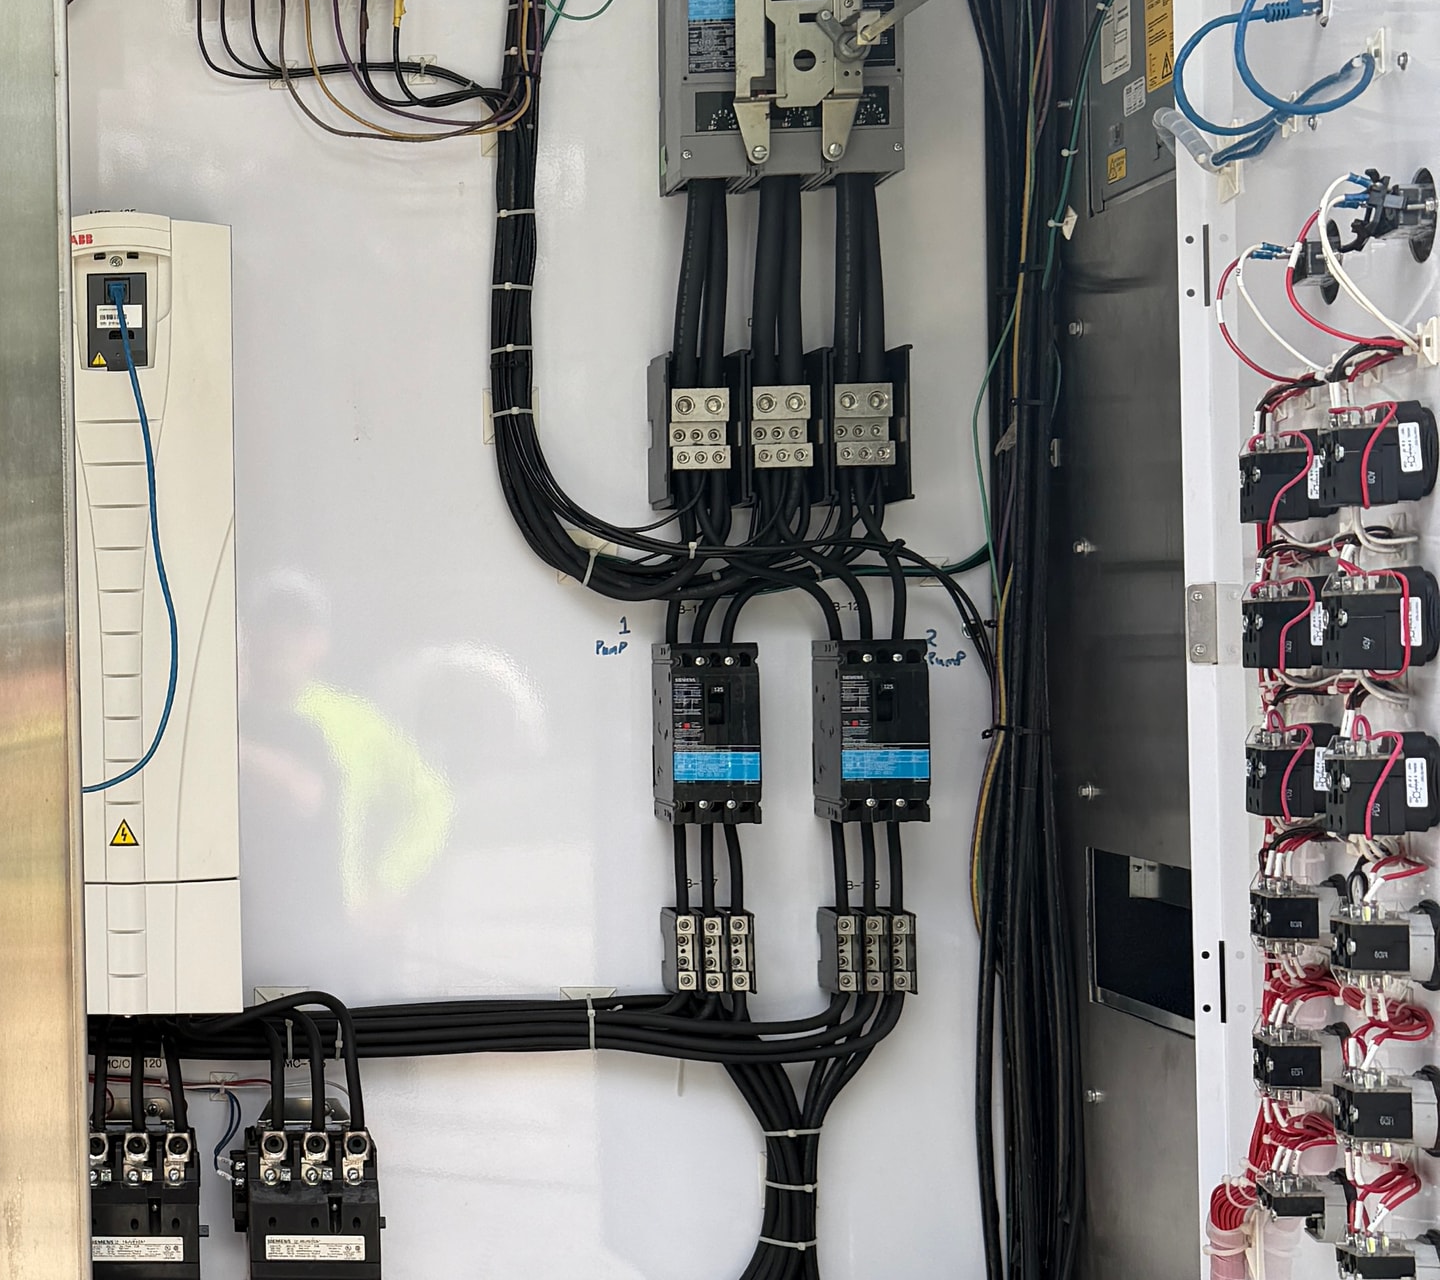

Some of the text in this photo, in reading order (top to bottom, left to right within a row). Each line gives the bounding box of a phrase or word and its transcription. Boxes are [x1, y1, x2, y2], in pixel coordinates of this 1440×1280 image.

[70, 233, 93, 245] ABB
[619, 616, 631, 634] 1
[927, 629, 937, 647] 2
